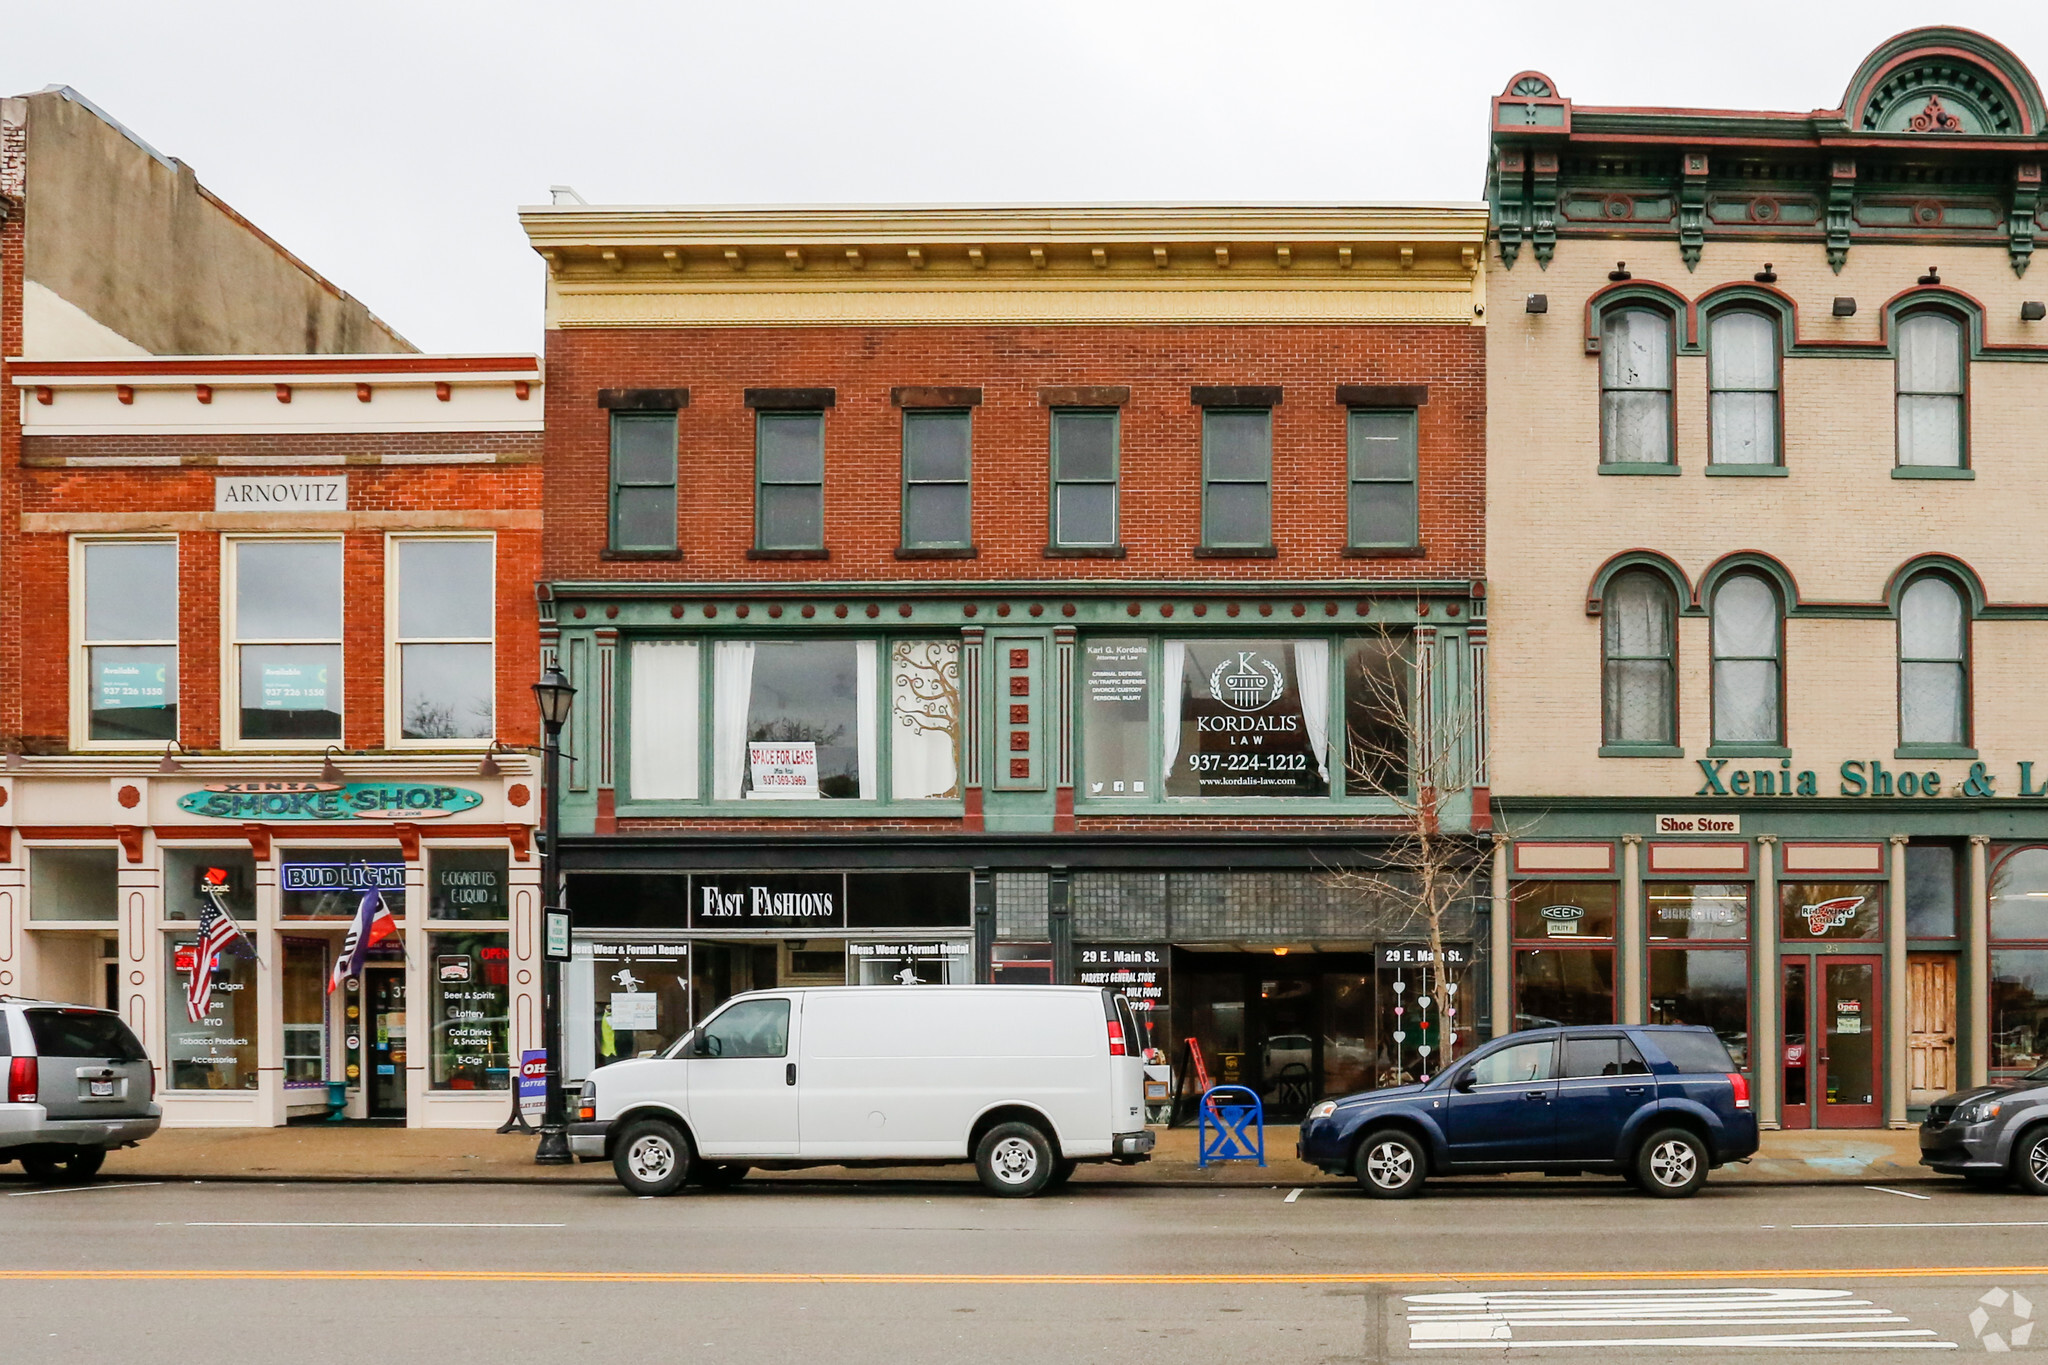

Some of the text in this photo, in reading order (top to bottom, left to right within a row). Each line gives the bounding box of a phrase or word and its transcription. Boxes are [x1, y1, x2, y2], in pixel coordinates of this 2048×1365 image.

[224, 484, 338, 502] ARNOVITZ
[1237, 652, 1259, 675] K
[103, 687, 163, 696] 937 226 1550
[264, 688, 325, 697] 937 226 1550
[1197, 715, 1297, 732] KORDALIS
[1230, 736, 1263, 745] LAW
[752, 749, 814, 765] SPACE FOR LEASE
[1189, 754, 1306, 771] 937-224-1212
[763, 775, 807, 786] 937-369-3969
[1199, 777, 1296, 786] www.kordalis-law.com
[1696, 759, 1817, 796] Xenia
[1840, 760, 1941, 797] Shoe
[1963, 761, 1996, 797] &
[224, 782, 320, 792] XENIA
[198, 787, 458, 818] SMOKE SHOP
[1661, 818, 1735, 832] Shoe Store
[288, 867, 406, 887] BUD LIGHT
[441, 871, 497, 887] E-CIGARETTES
[451, 889, 488, 904] E-LIQUID
[1543, 907, 1582, 918] KEEN
[1825, 908, 1854, 916] WING
[481, 948, 509, 960] OPEN
[593, 945, 617, 955] Wear
[618, 946, 625, 955] &
[626, 945, 657, 955] Formal
[658, 945, 687, 955] Rental
[849, 944, 969, 955] Mens Wear & Formal Rental
[1826, 944, 1838, 953] 25
[1082, 950, 1160, 962] 29 E. Main St.
[1386, 950, 1463, 962] 29 E. Ma St.
[1081, 972, 1156, 983] PARKER'S GENERAL STORE
[218, 983, 244, 991] Cigars
[1126, 987, 1142, 997] BULK
[1143, 987, 1162, 997] FOODS
[444, 991, 462, 999] Beer
[472, 992, 495, 1000] Spirits
[1837, 1003, 1859, 1013] Open
[456, 1010, 484, 1019] Lottery
[203, 1018, 223, 1026] RYO
[179, 1037, 248, 1045] Tobacco Products
[191, 1056, 237, 1064] Accessories
[458, 1056, 483, 1065] E-Cigs
[523, 1063, 546, 1075] OH
[521, 1079, 546, 1088] LOTTER
